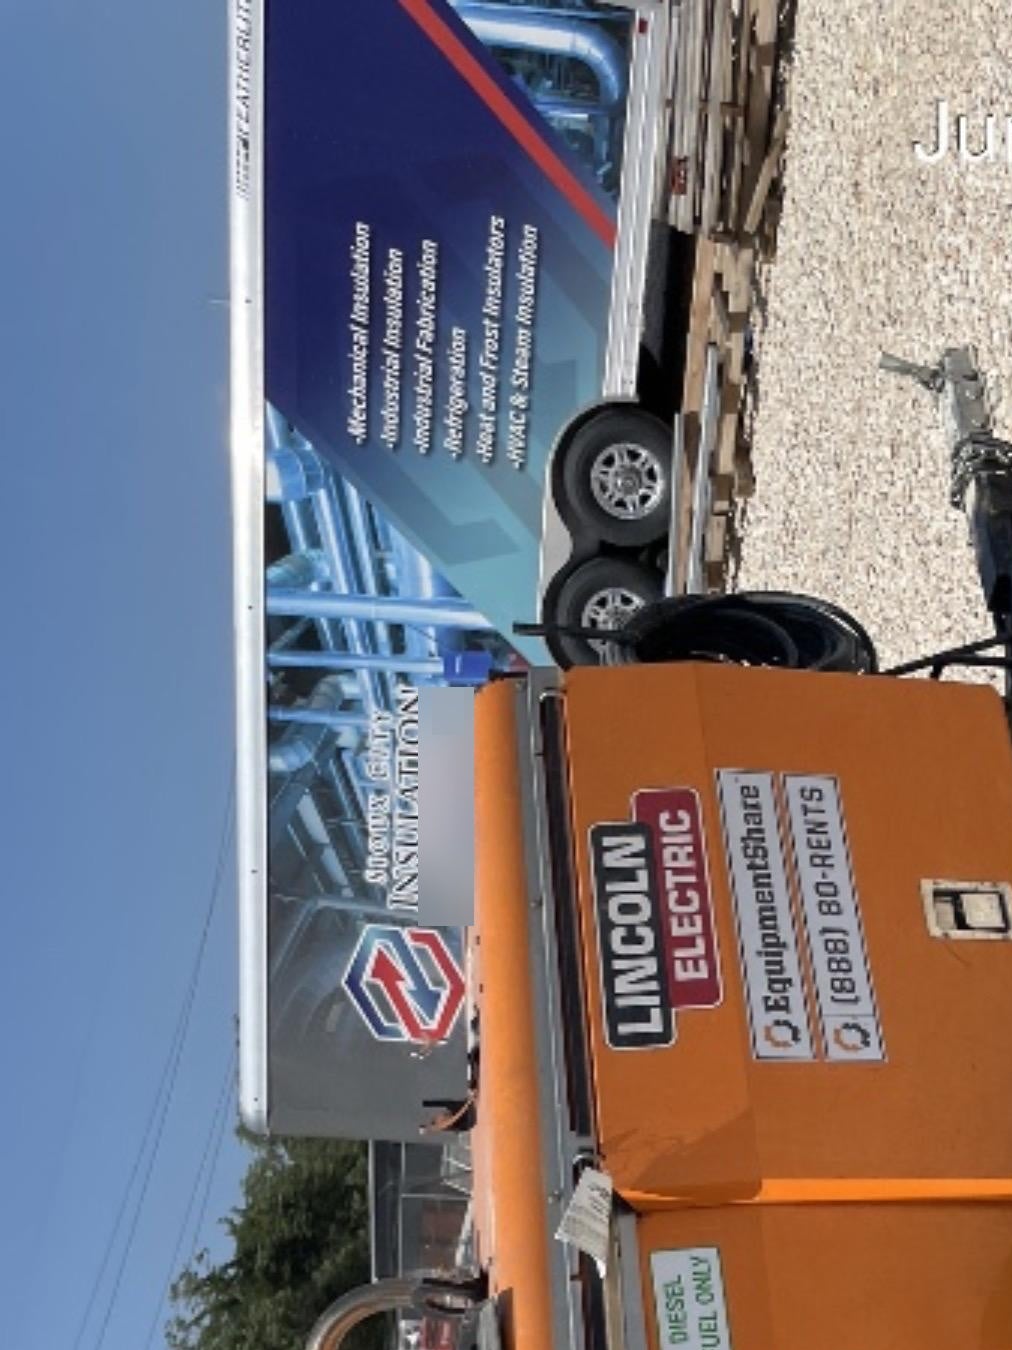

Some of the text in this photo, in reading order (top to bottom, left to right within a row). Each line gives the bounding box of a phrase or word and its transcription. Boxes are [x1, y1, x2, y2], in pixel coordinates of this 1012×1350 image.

[236, 0, 251, 137] FEATHERLIT
[349, 222, 370, 324] Insulation
[383, 248, 403, 348] Insulation
[415, 239, 437, 354] Fabrication
[482, 215, 505, 316] Insulators
[515, 224, 539, 325] Insulation
[479, 318, 499, 370] Frost
[479, 371, 496, 411] and
[510, 329, 531, 389] Steam
[509, 392, 528, 409] &
[602, 834, 664, 1036] LINCOLN
[659, 809, 709, 982] ELECTRIC
[739, 785, 793, 1015] EquipmentShare
[800, 787, 860, 1004] (888) 80-RENTS
[663, 1275, 689, 1344] DIESEL
[689, 1256, 714, 1305] ONLY
